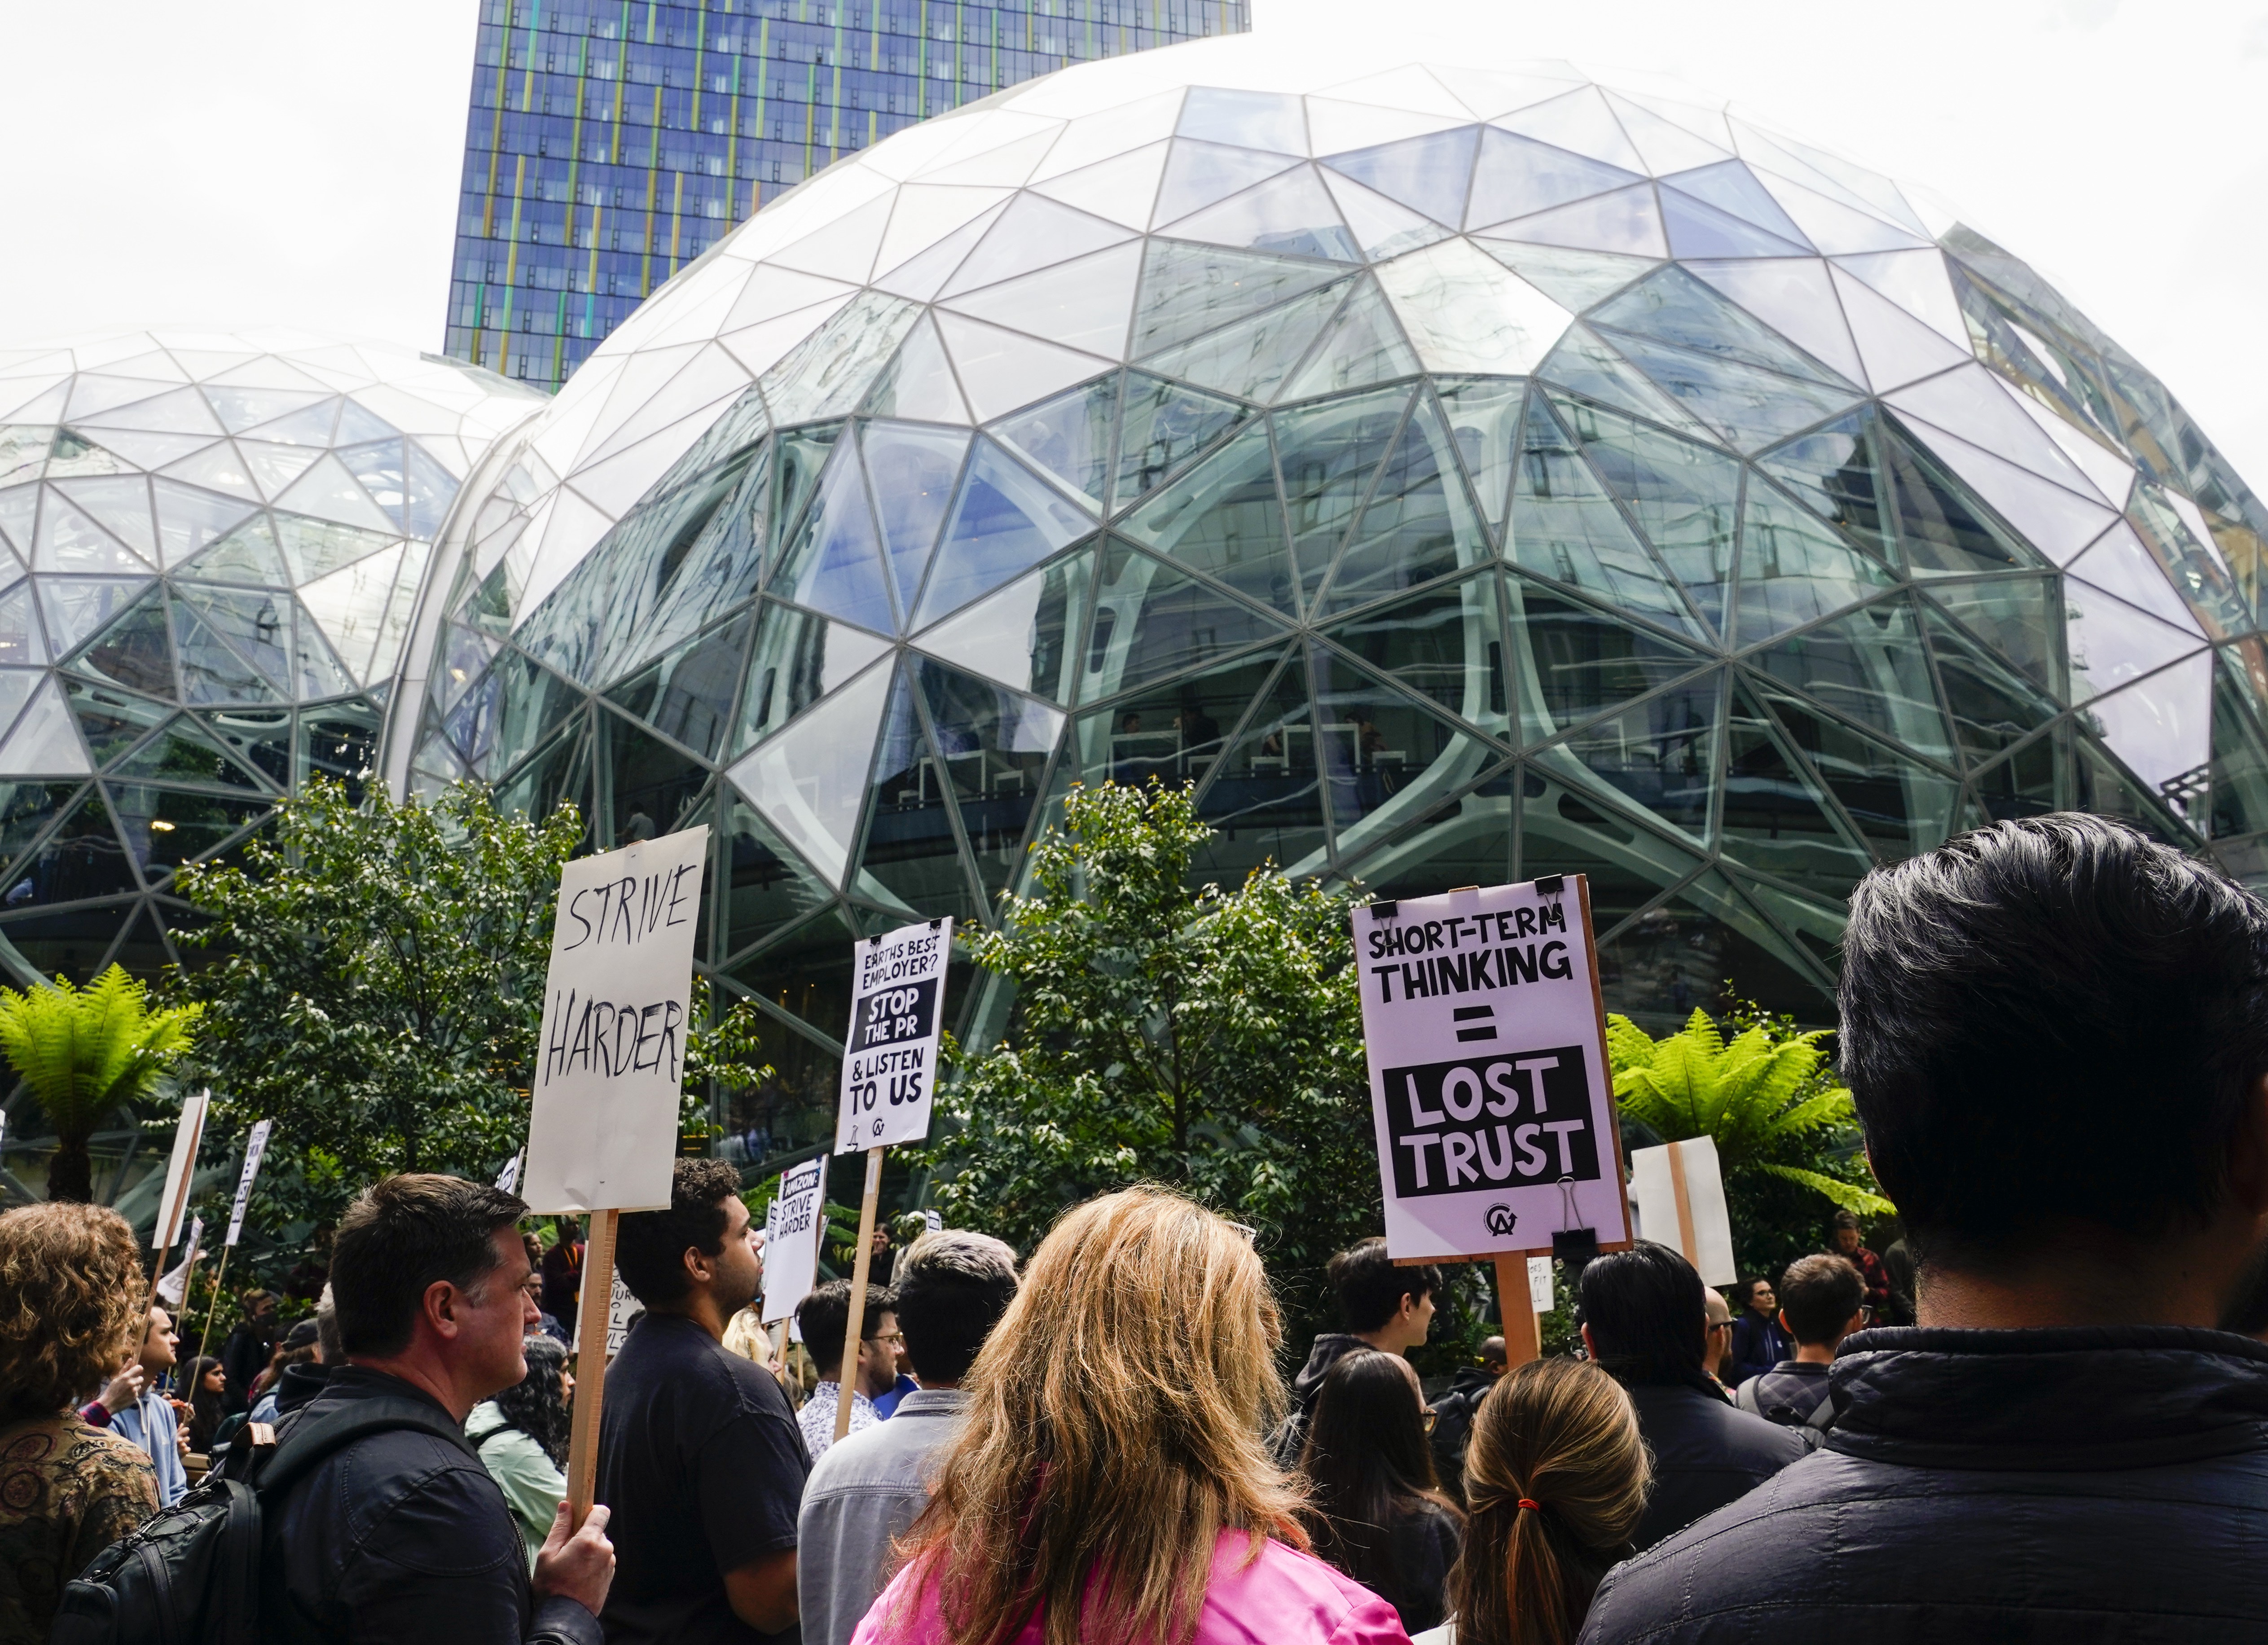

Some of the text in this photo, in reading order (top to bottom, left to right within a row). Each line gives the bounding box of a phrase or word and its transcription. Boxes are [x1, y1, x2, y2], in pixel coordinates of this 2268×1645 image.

[564, 864, 697, 951] STRIVE
[908, 935, 940, 956] BEST
[1369, 903, 1567, 960] SHORT-TERM
[862, 953, 938, 991] EMPLOYER?
[1371, 940, 1574, 1004] THINKING
[868, 987, 919, 1023] STOP
[545, 988, 683, 1086] HARDER
[865, 1014, 918, 1045] THE PR
[866, 1046, 924, 1078] LISTEN
[849, 1072, 923, 1116] TO US
[1406, 1056, 1559, 1129] LOST
[1399, 1119, 1585, 1189] TRUST
[782, 1193, 814, 1221] STRIVE
[778, 1213, 810, 1240] HARDER
[1534, 1276, 1547, 1285] FIT
